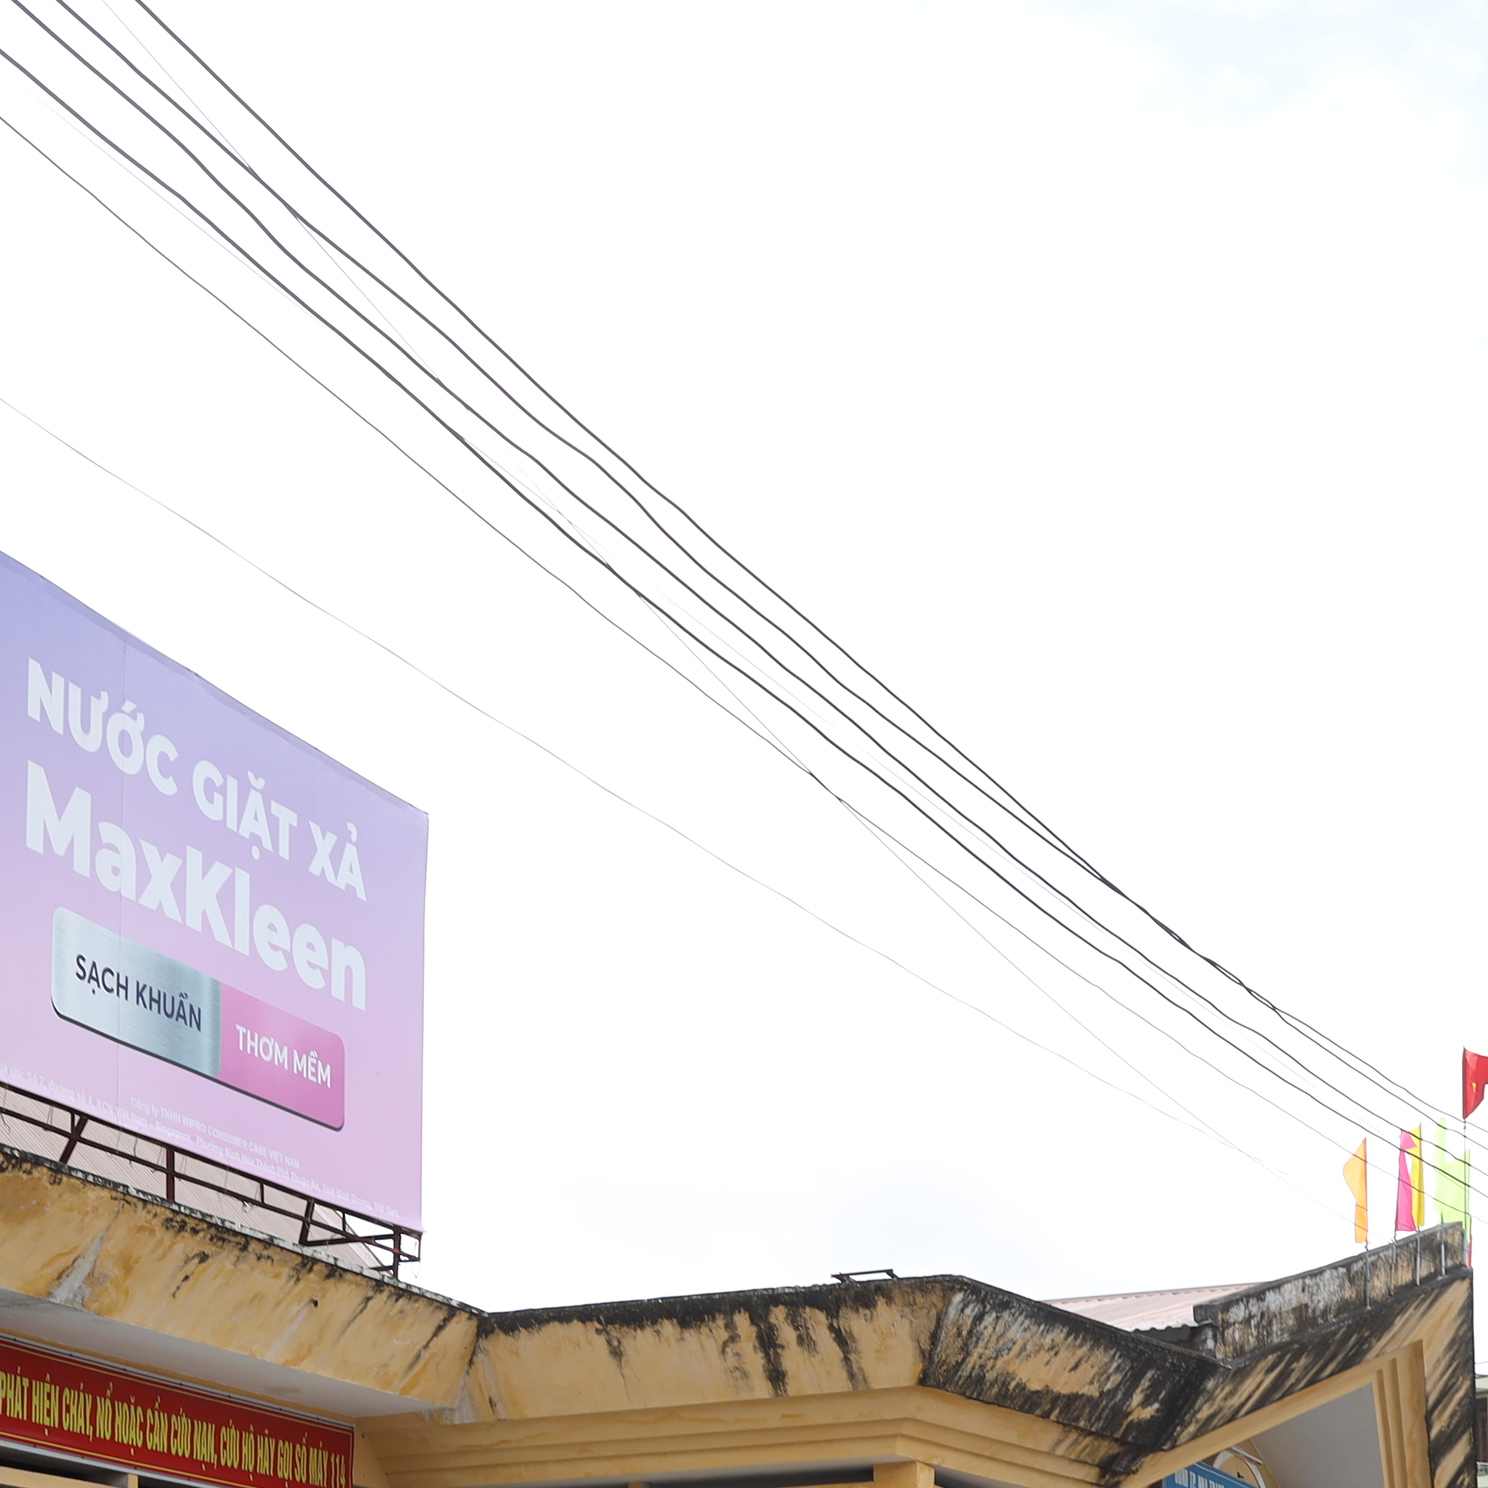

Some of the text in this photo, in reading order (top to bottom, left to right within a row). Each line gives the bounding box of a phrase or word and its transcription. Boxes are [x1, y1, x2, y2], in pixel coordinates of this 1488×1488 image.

[27, 656, 368, 902] NƯỚC GIẶT XẢ
[26, 759, 367, 1011] MaxKleen
[75, 954, 202, 1033] SẠCH KHUẨN
[236, 1024, 331, 1089] THƠM MỀM
[130, 1096, 152, 1117] Công
[182, 1112, 207, 1133] WIPRO
[209, 1125, 248, 1149] CONSUMER
[249, 1139, 268, 1157] CARE
[285, 1154, 300, 1170] NAM
[32, 1373, 60, 1436] HIỆN
[62, 1383, 94, 1442] CHÁY,
[96, 1382, 113, 1441] NỔ
[114, 1395, 144, 1456] HOẶC
[171, 1407, 191, 1458] CỨU
[193, 1419, 217, 1471] NẠN,
[220, 1419, 240, 1470] CỨU
[242, 1424, 255, 1481] HỘ
[277, 1439, 293, 1488] GỌI
[294, 1431, 307, 1484] SỐ
[309, 1441, 329, 1488] MÁY
